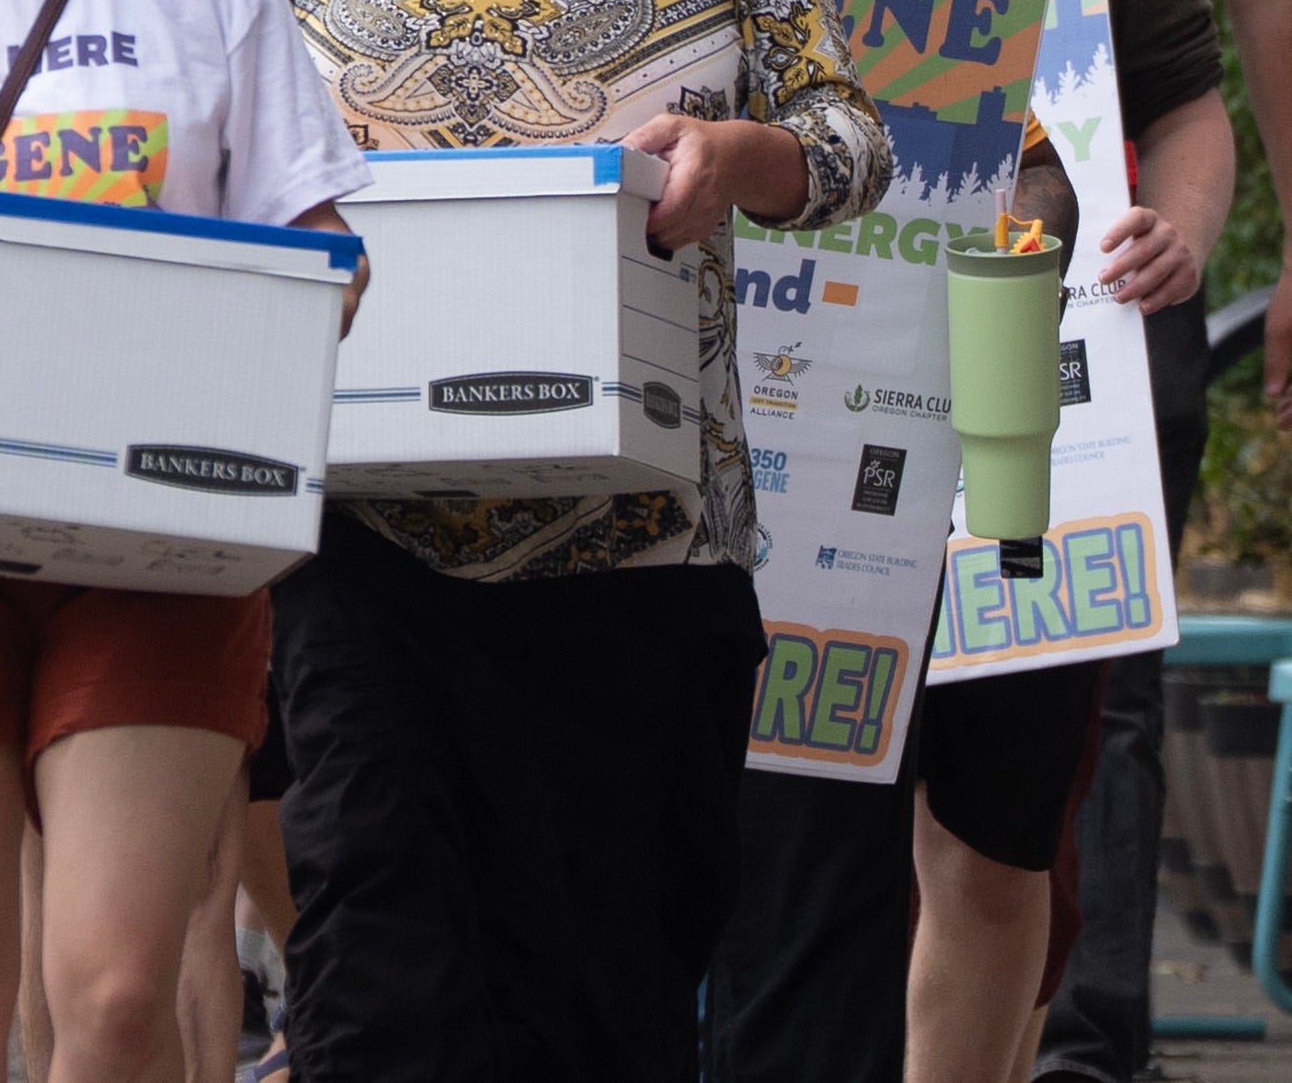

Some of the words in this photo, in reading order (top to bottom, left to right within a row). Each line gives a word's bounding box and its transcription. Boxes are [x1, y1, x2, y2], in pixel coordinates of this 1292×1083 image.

[735, 259, 816, 314] nd
[1060, 361, 1082, 381] SR
[442, 383, 534, 403] BANKERS
[538, 382, 581, 400] BOX
[753, 385, 799, 400] OREGON
[874, 389, 923, 410] SIERRA
[926, 397, 952, 414] CLU
[750, 407, 794, 420] ALLIANCE
[872, 405, 907, 416] OREGON
[909, 410, 948, 421] CHAPTER
[751, 448, 787, 471] 350
[869, 448, 900, 458] OREGON
[139, 452, 237, 480] BANKERS
[240, 463, 286, 487] BOX
[863, 466, 896, 488] PSR
[753, 470, 790, 493] GENE
[862, 563, 890, 575] COUNCIL
[868, 554, 885, 564] STATE
[751, 633, 898, 755] RE!
